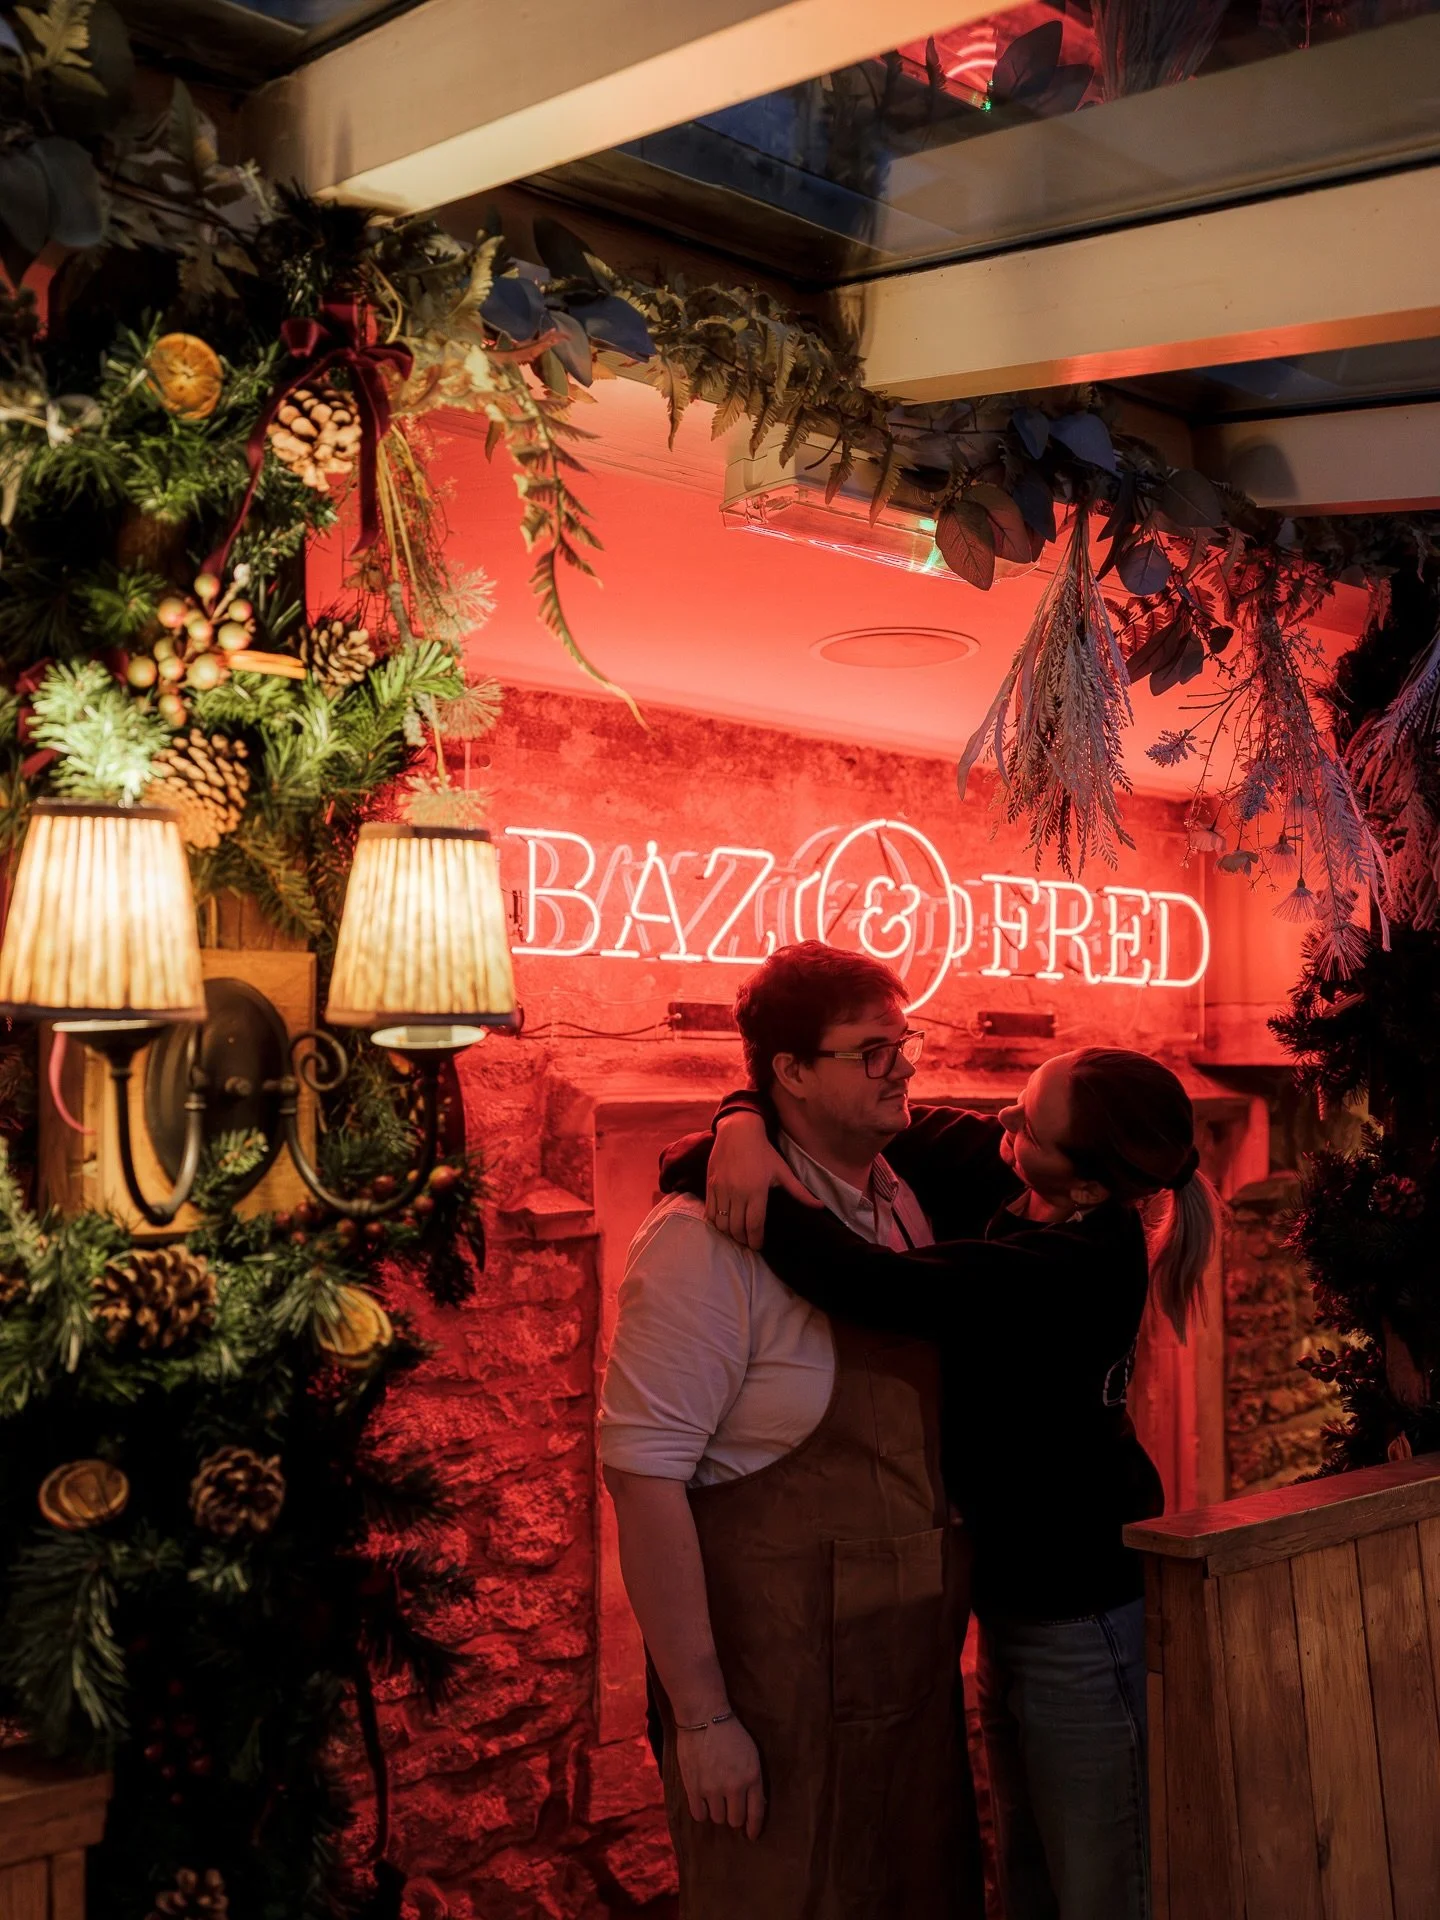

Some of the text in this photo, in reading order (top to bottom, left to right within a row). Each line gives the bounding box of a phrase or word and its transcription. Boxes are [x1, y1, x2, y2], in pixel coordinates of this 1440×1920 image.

[504, 825, 1211, 988] BAZ & FRED
